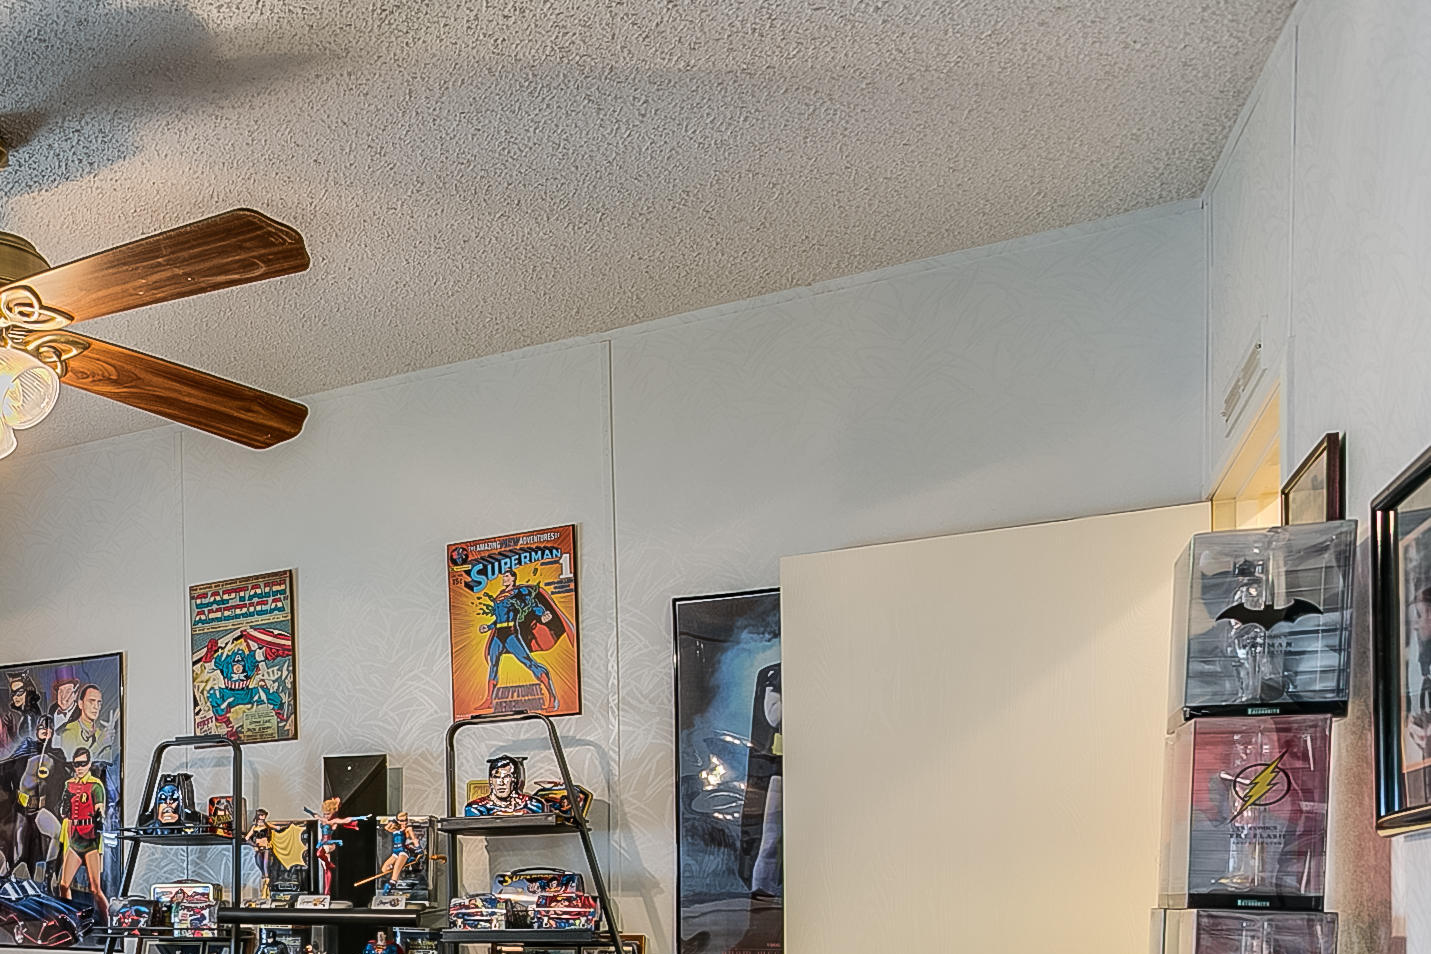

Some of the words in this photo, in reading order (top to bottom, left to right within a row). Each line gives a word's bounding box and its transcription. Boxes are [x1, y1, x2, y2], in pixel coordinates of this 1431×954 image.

[476, 541, 501, 551] AMAZING
[519, 533, 555, 545] ADVENTURES
[467, 547, 561, 593] SUPERMAN
[559, 553, 574, 579] 1
